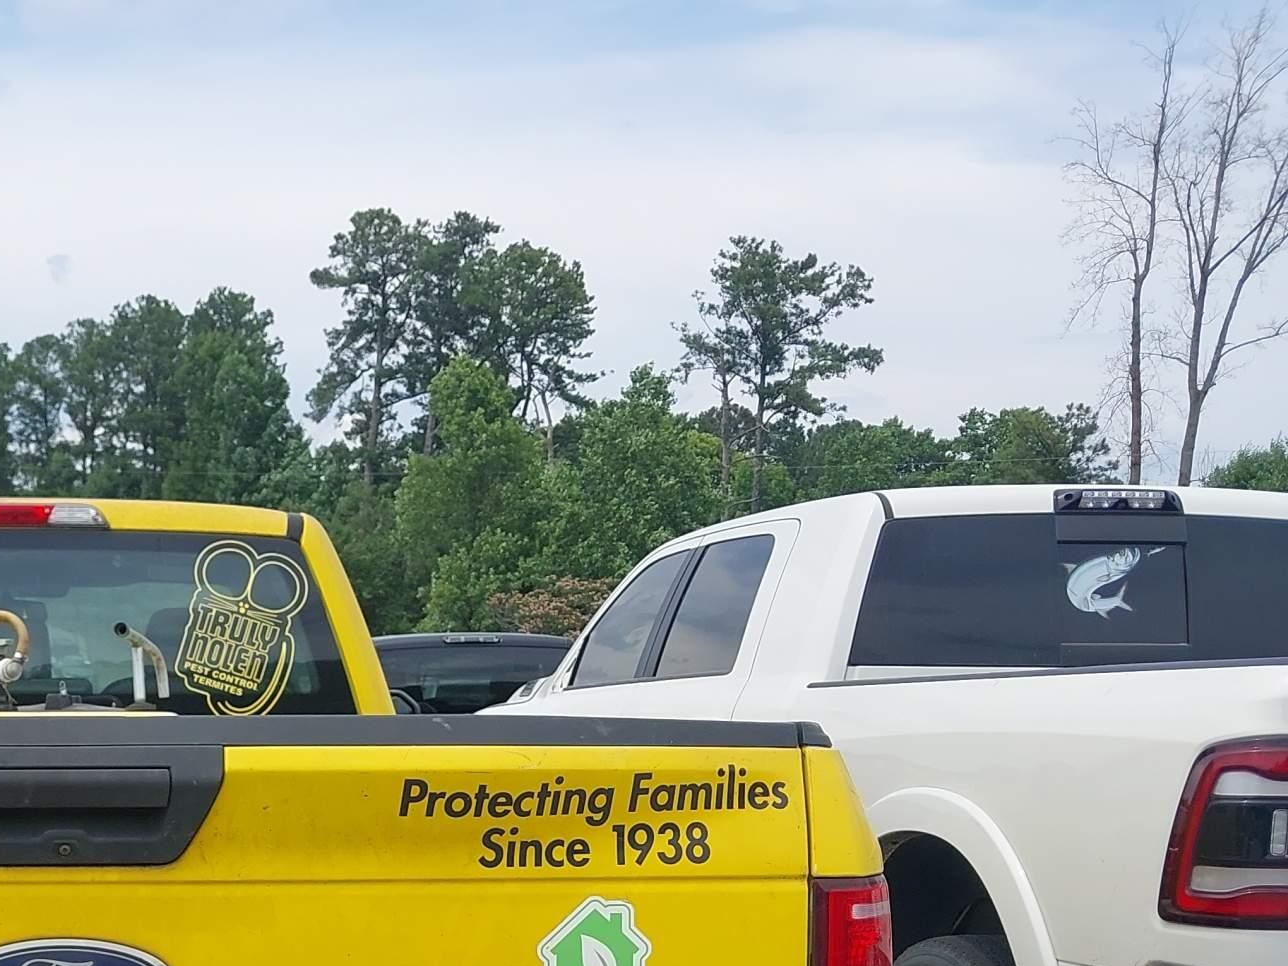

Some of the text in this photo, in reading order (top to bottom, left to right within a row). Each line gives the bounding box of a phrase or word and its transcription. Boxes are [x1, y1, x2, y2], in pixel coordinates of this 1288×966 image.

[198, 602, 280, 653] TRULY
[184, 661, 260, 692] PEST CONTROL
[186, 630, 269, 683] NOLEN
[193, 673, 244, 697] TERMITES
[398, 764, 790, 827] Protecting Families
[478, 821, 712, 868] Since 1938
